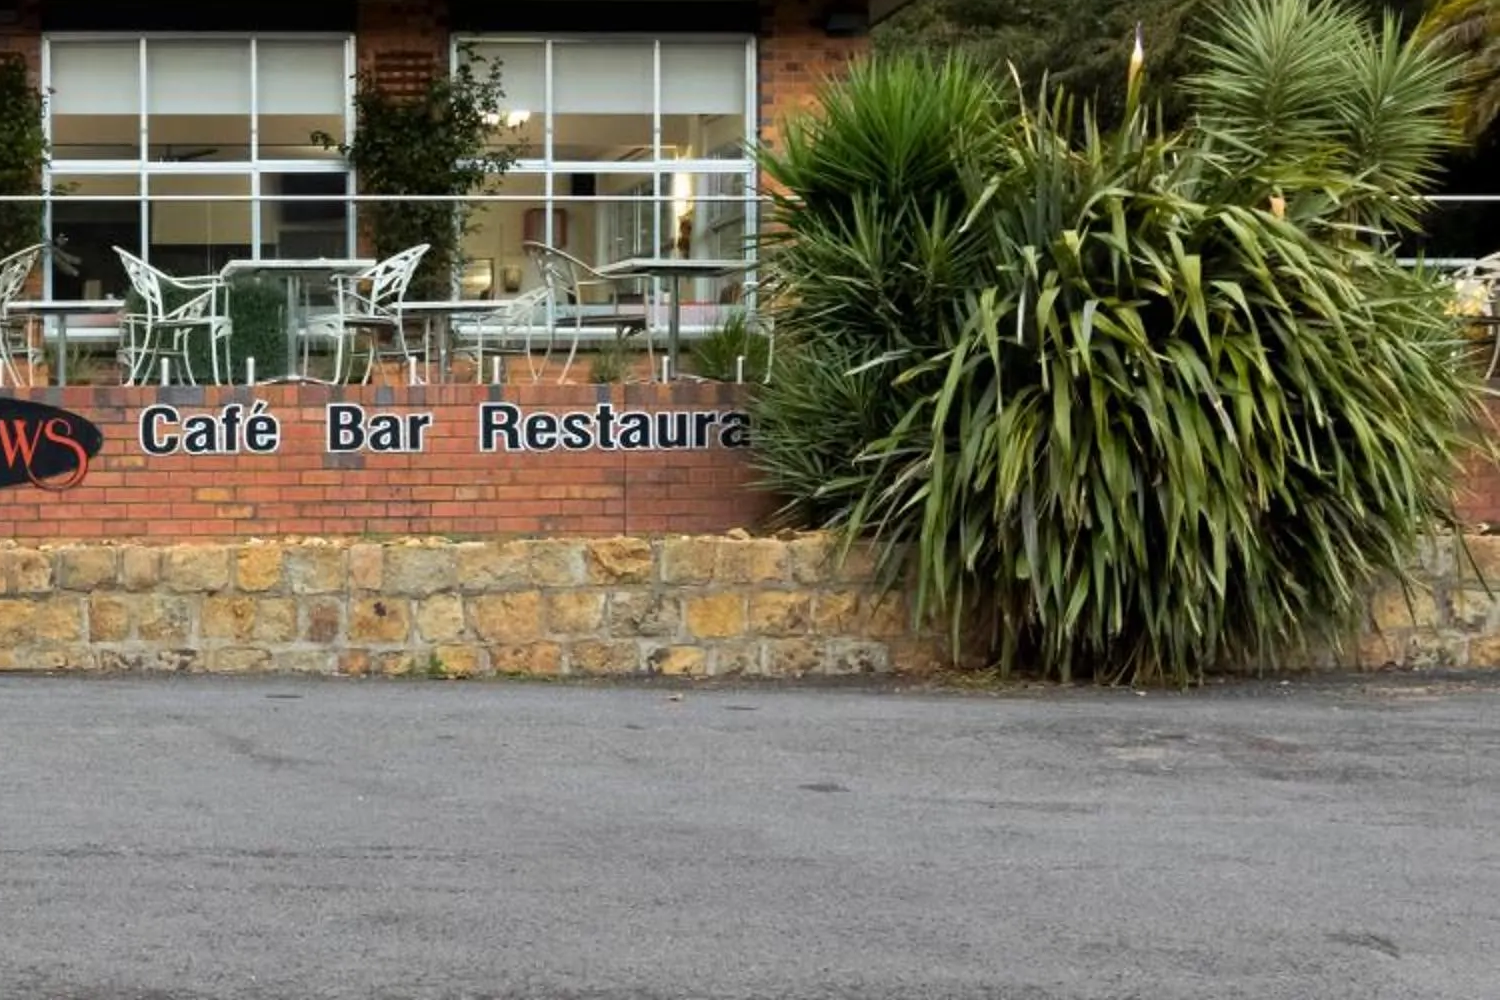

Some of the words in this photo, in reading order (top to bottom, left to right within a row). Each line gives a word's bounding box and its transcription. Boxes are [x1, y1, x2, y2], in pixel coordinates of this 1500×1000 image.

[139, 399, 280, 456] Café
[326, 402, 432, 452] Bar
[479, 401, 753, 452] Restaura
